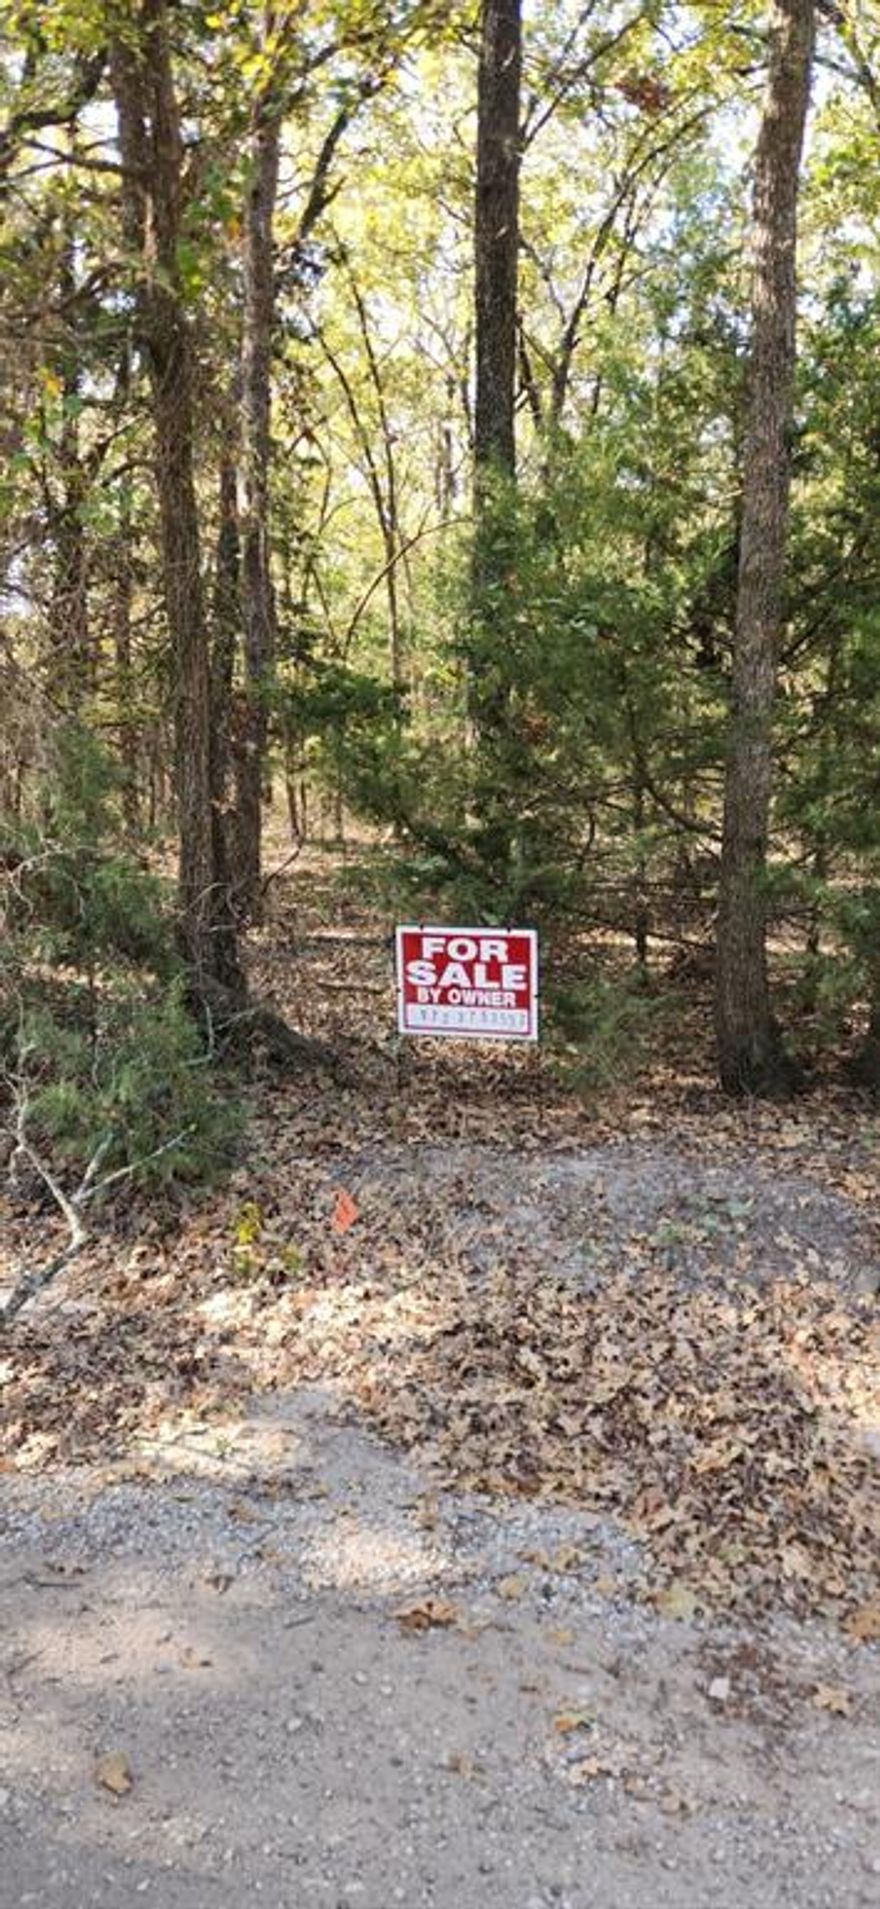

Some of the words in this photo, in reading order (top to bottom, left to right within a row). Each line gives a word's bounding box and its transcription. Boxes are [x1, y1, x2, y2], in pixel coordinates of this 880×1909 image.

[421, 937, 509, 962] FOR
[406, 959, 527, 990] SALE
[417, 987, 441, 1004] BY
[447, 988, 516, 1008] OWNER
